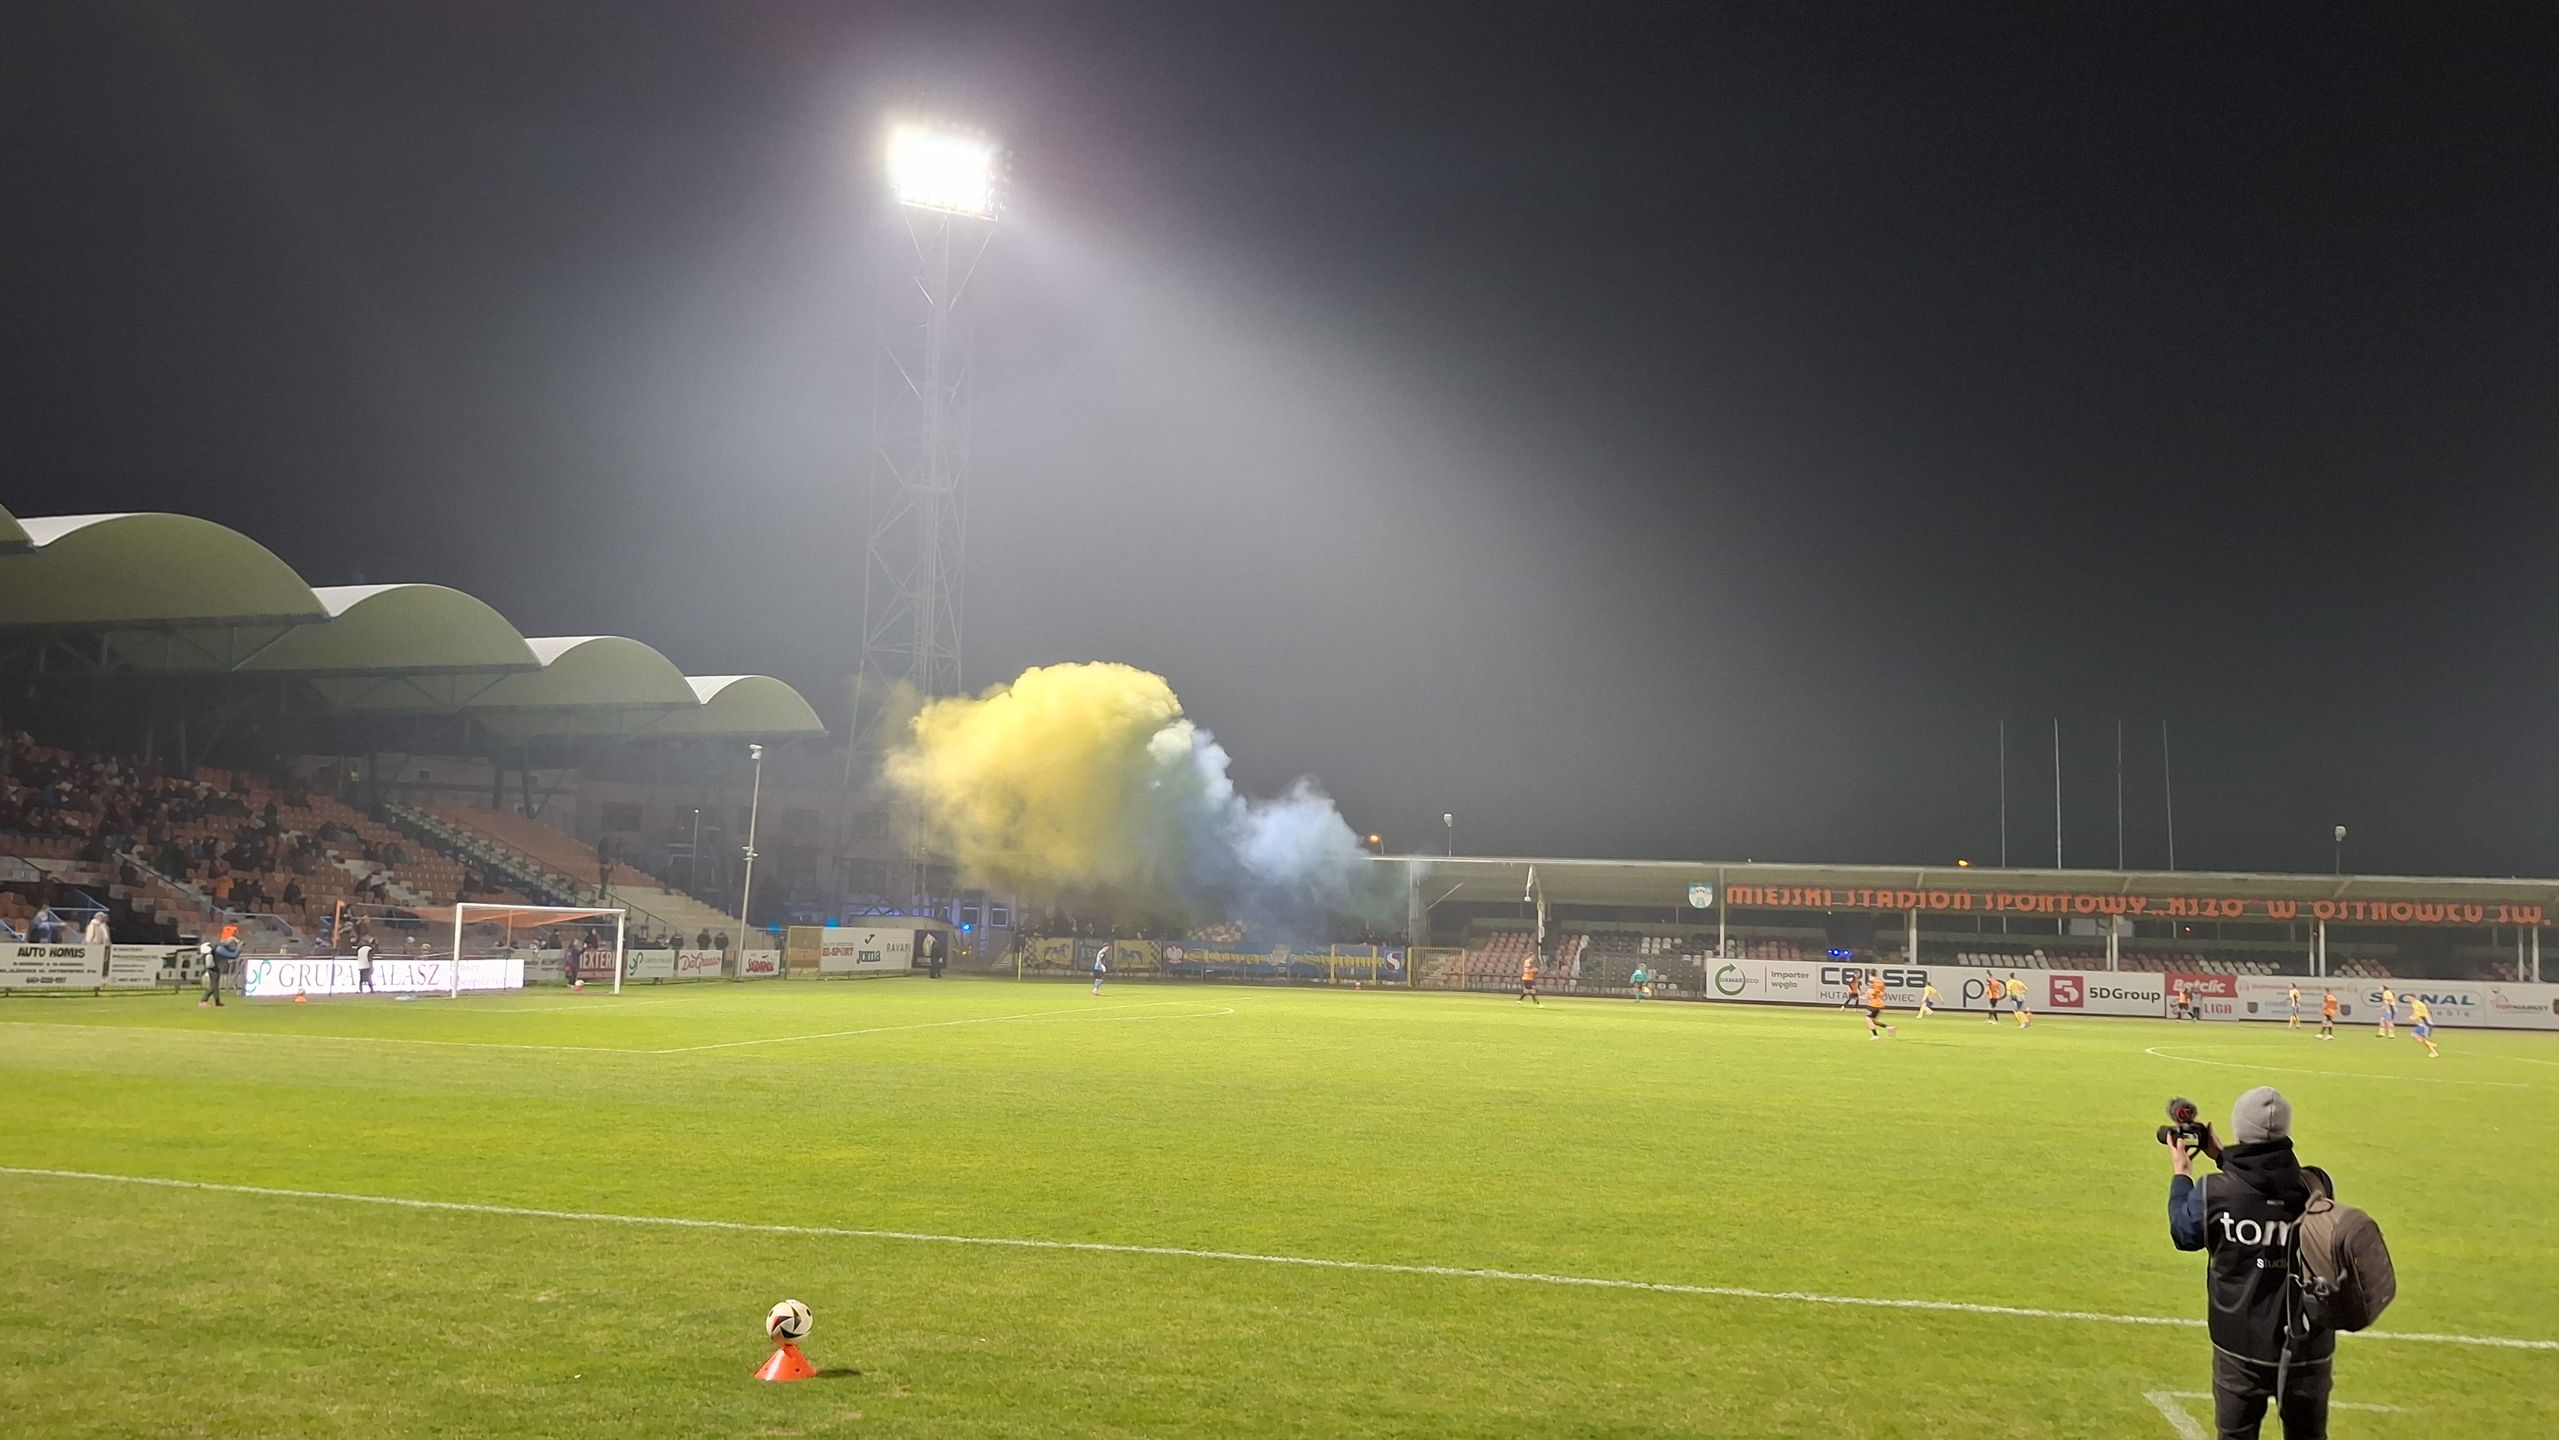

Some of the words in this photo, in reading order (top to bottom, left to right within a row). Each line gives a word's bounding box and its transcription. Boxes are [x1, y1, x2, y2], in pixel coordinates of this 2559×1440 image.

[1727, 886, 1832, 907] MIEJSKI
[1846, 888, 1972, 911] STADION
[1984, 892, 2148, 915] SPORTOWY
[2267, 899, 2296, 919] W
[2313, 900, 2483, 923] OSTROWCU
[17, 947, 46, 957] AUTO
[279, 963, 355, 987] GRUPA
[358, 963, 440, 986] AŁASZ
[2369, 992, 2475, 1005] SGNAL
